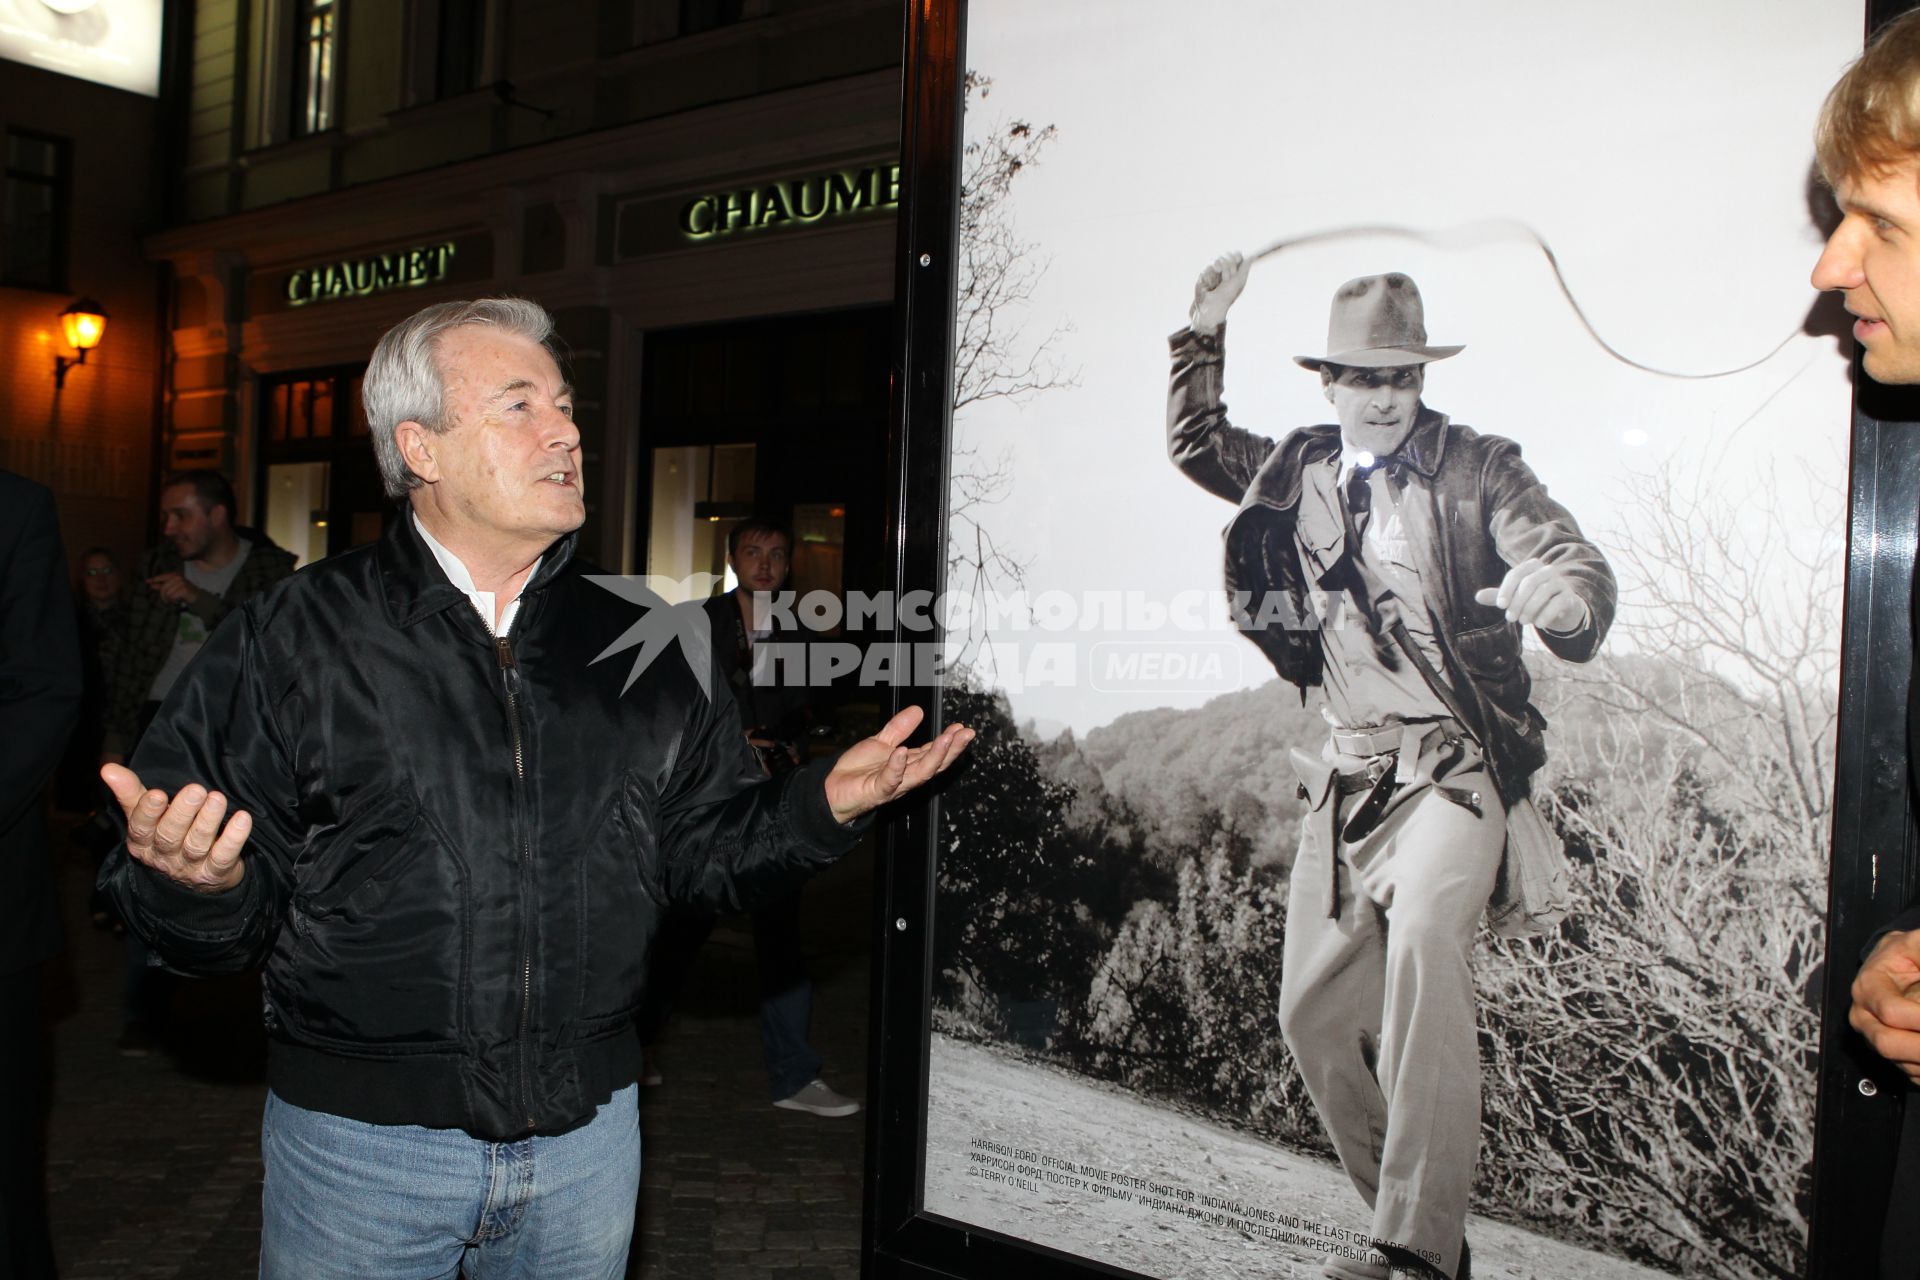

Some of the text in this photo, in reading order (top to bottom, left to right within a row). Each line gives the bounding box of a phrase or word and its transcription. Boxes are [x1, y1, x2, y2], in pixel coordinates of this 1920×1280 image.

[286, 243, 455, 306] CHAUMET
[971, 1137, 1013, 1157] HARRISON
[1041, 1155, 1078, 1174] OFFICIAL
[1080, 1165, 1108, 1182] MOVIE
[1111, 1172, 1147, 1191] POSTER
[1149, 1183, 1174, 1197] SHOT
[1176, 1189, 1195, 1203] FOR
[1243, 1206, 1275, 1223] JONES
[1278, 1214, 1299, 1229] AND
[1302, 1219, 1321, 1235] THE
[1324, 1225, 1350, 1242] LAST
[1416, 1249, 1441, 1265] 1989
[971, 1152, 1015, 1172] ХАРРИСОН
[1047, 1171, 1081, 1189] ПОСТЕР
[1083, 1181, 1089, 1191] К
[1092, 1183, 1133, 1202] ФИЛЬМУ
[1187, 1207, 1224, 1226] ДЖОНС
[1227, 1218, 1234, 1229] И
[1237, 1221, 1300, 1244] ПОСЛЕДНИЙ
[1302, 1237, 1367, 1261] КРЕСТОВЫЙ
[980, 1168, 1006, 1183] TERRY
[1008, 1176, 1039, 1193] O'NEILL
